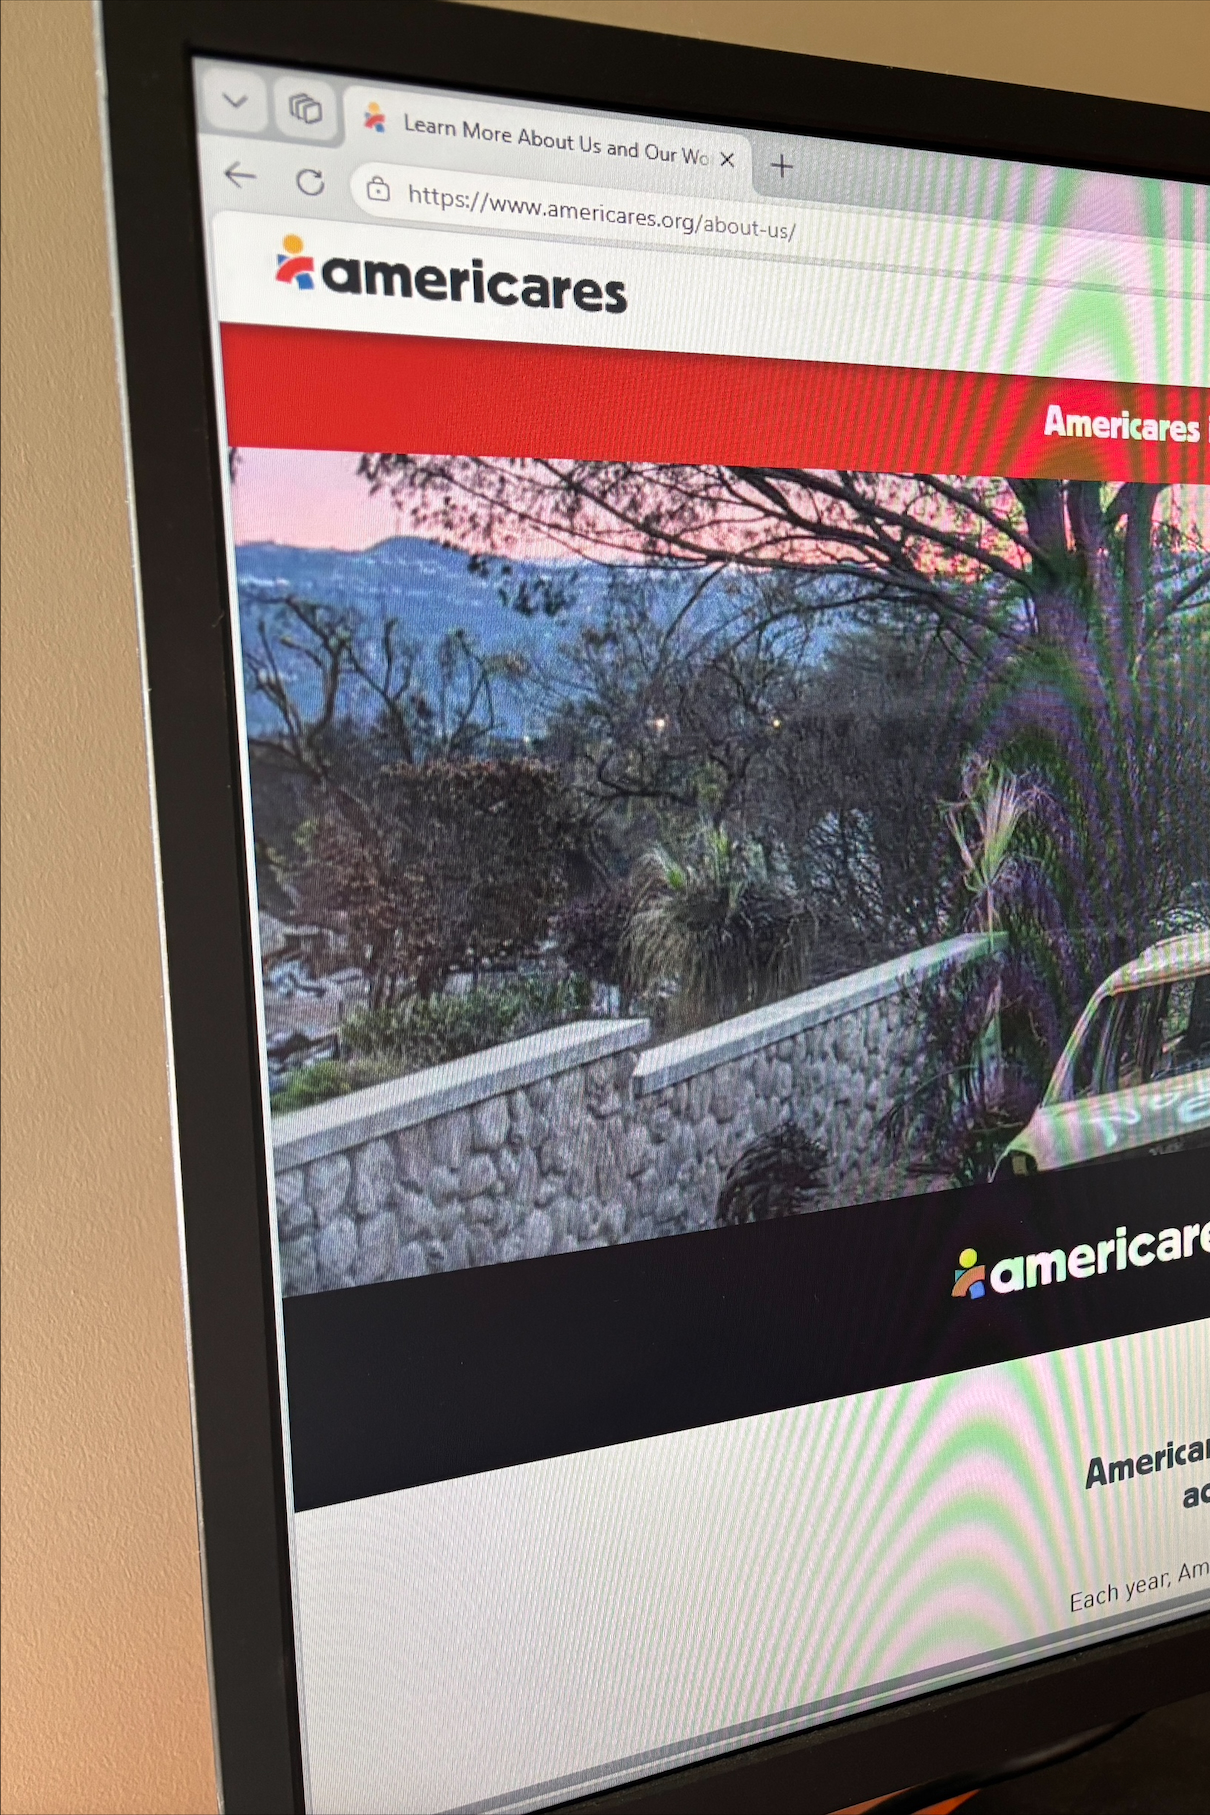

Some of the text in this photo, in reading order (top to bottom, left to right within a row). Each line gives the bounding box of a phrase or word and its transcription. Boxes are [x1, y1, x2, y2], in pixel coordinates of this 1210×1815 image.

[404, 113, 456, 136] Learn
[463, 121, 512, 143] More
[518, 128, 574, 151] About
[580, 135, 601, 154] Us
[607, 142, 639, 158] and
[645, 144, 676, 163] Our
[408, 183, 797, 242] https://www.americares.org/about-us/
[321, 258, 628, 314] americares
[1044, 404, 1200, 444] Americares
[1070, 1584, 1119, 1613] Each
[1124, 1570, 1172, 1600] year,
